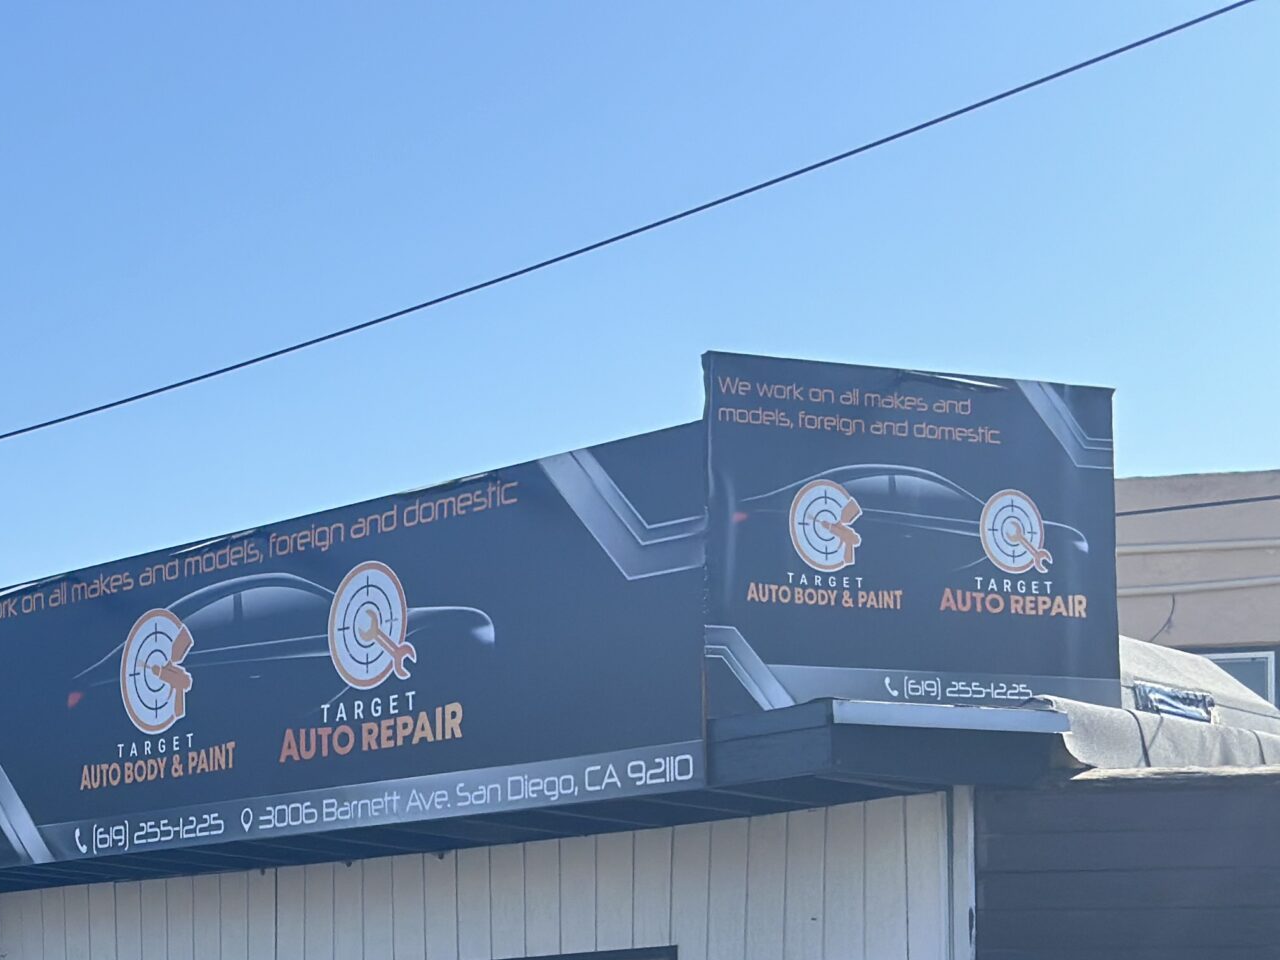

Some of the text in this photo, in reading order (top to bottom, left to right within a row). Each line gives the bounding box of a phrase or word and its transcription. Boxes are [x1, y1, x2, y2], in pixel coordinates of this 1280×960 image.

[717, 375, 971, 416] We work on all makes and
[718, 406, 1001, 445] models, foreign and domestic
[21, 592, 45, 614] on
[48, 581, 67, 607] all
[72, 571, 134, 602] makes
[139, 557, 179, 587] and
[184, 539, 264, 578] models,
[269, 522, 345, 558] foreign
[350, 505, 397, 540] and
[403, 481, 518, 528] domestic
[747, 582, 903, 611] AUTO BODY & PAINT
[786, 572, 864, 589] TARGET
[975, 576, 1053, 594] TARGET
[939, 588, 1088, 619] AUTO REPAIR
[904, 675, 1033, 700] (619) 255-1225
[321, 691, 417, 723] TARGET
[117, 733, 194, 758] TARGET
[278, 702, 464, 763] AUTO REPAIR
[80, 741, 236, 791] AUTO BODY & PAINT
[258, 753, 694, 830] 3006 Barnett Ave. San Diego, CA 92110
[92, 812, 224, 854] (619) 255-1225
